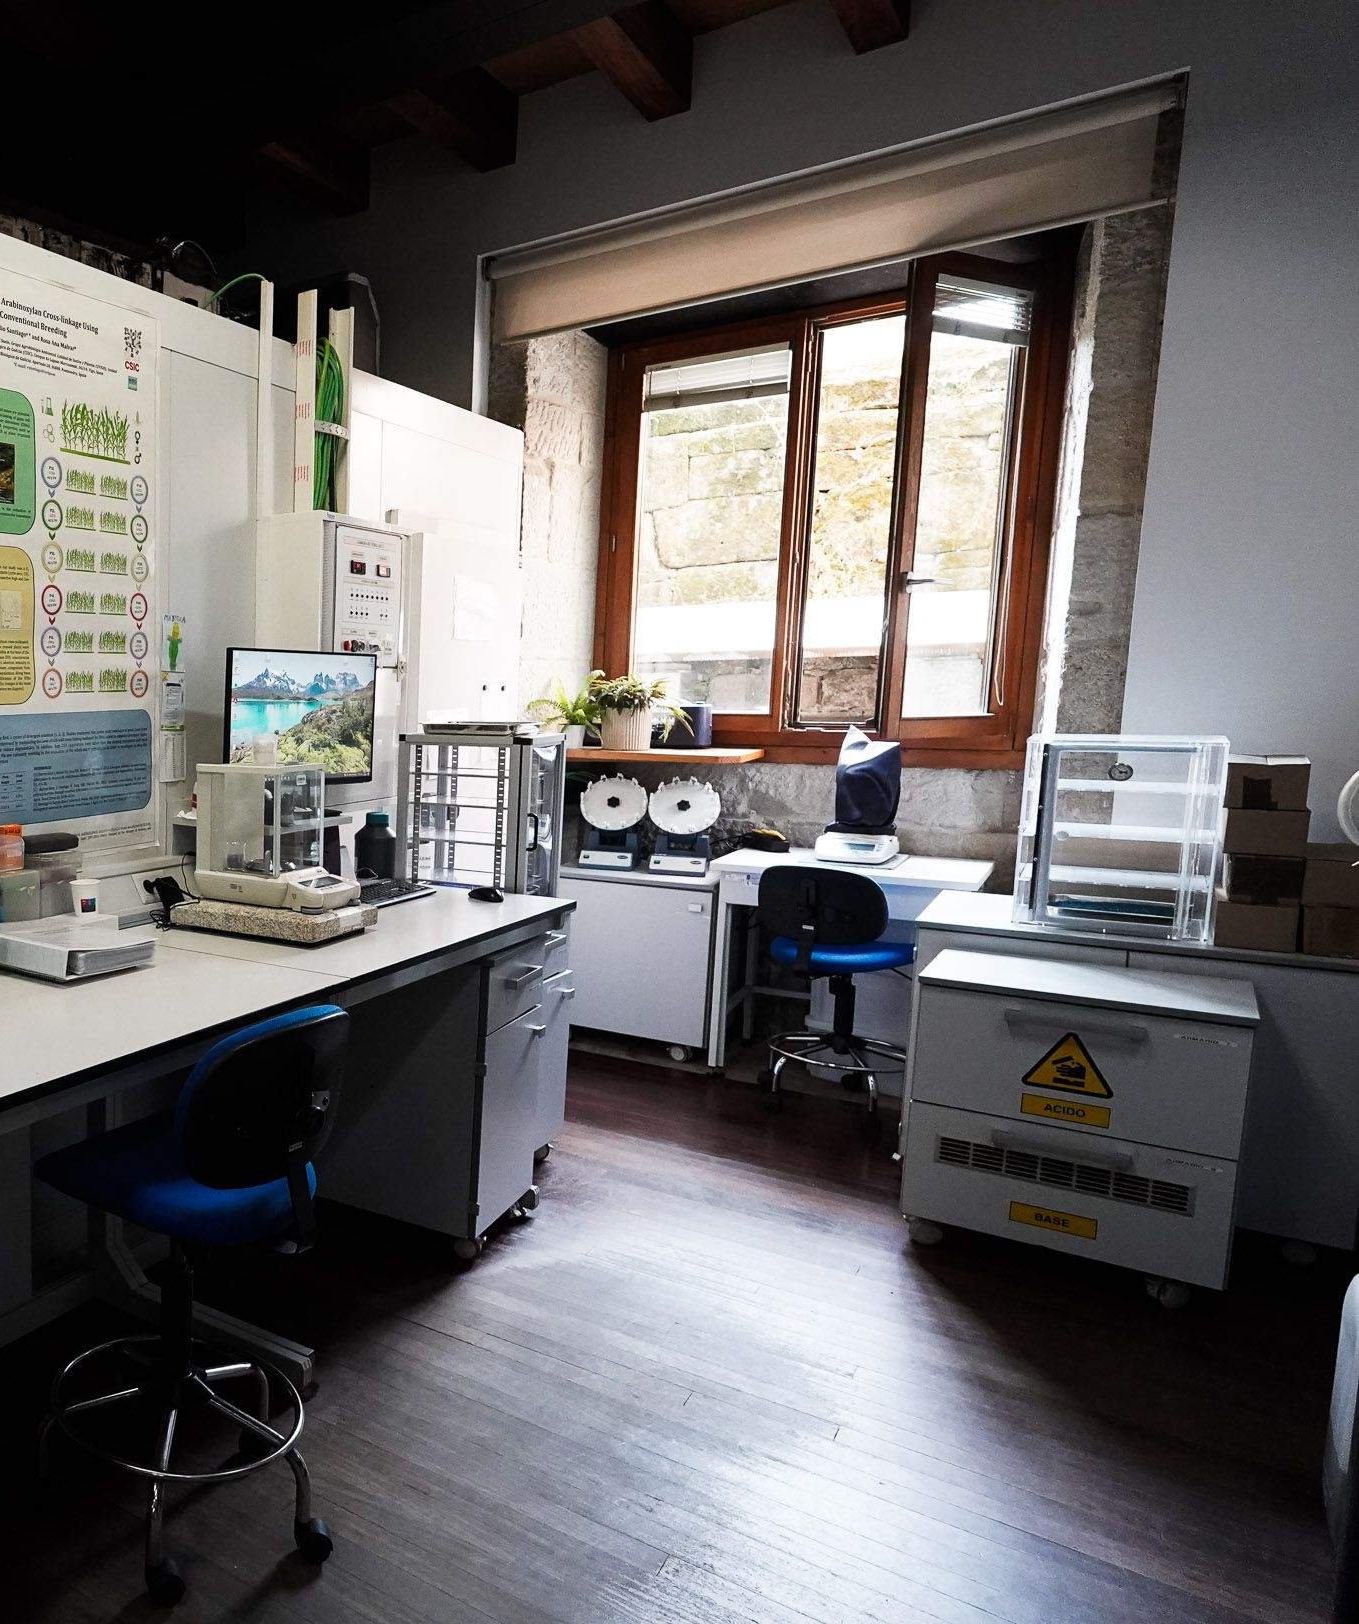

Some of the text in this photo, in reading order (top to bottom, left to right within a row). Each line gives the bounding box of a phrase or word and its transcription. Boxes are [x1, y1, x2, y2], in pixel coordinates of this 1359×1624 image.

[0, 297, 41, 317] Arabinoxylan
[0, 310, 67, 338] Conventional Breeding
[124, 361, 139, 372] CSIC
[1043, 1103, 1086, 1118] ACIDO
[1034, 1213, 1070, 1228] BASE
